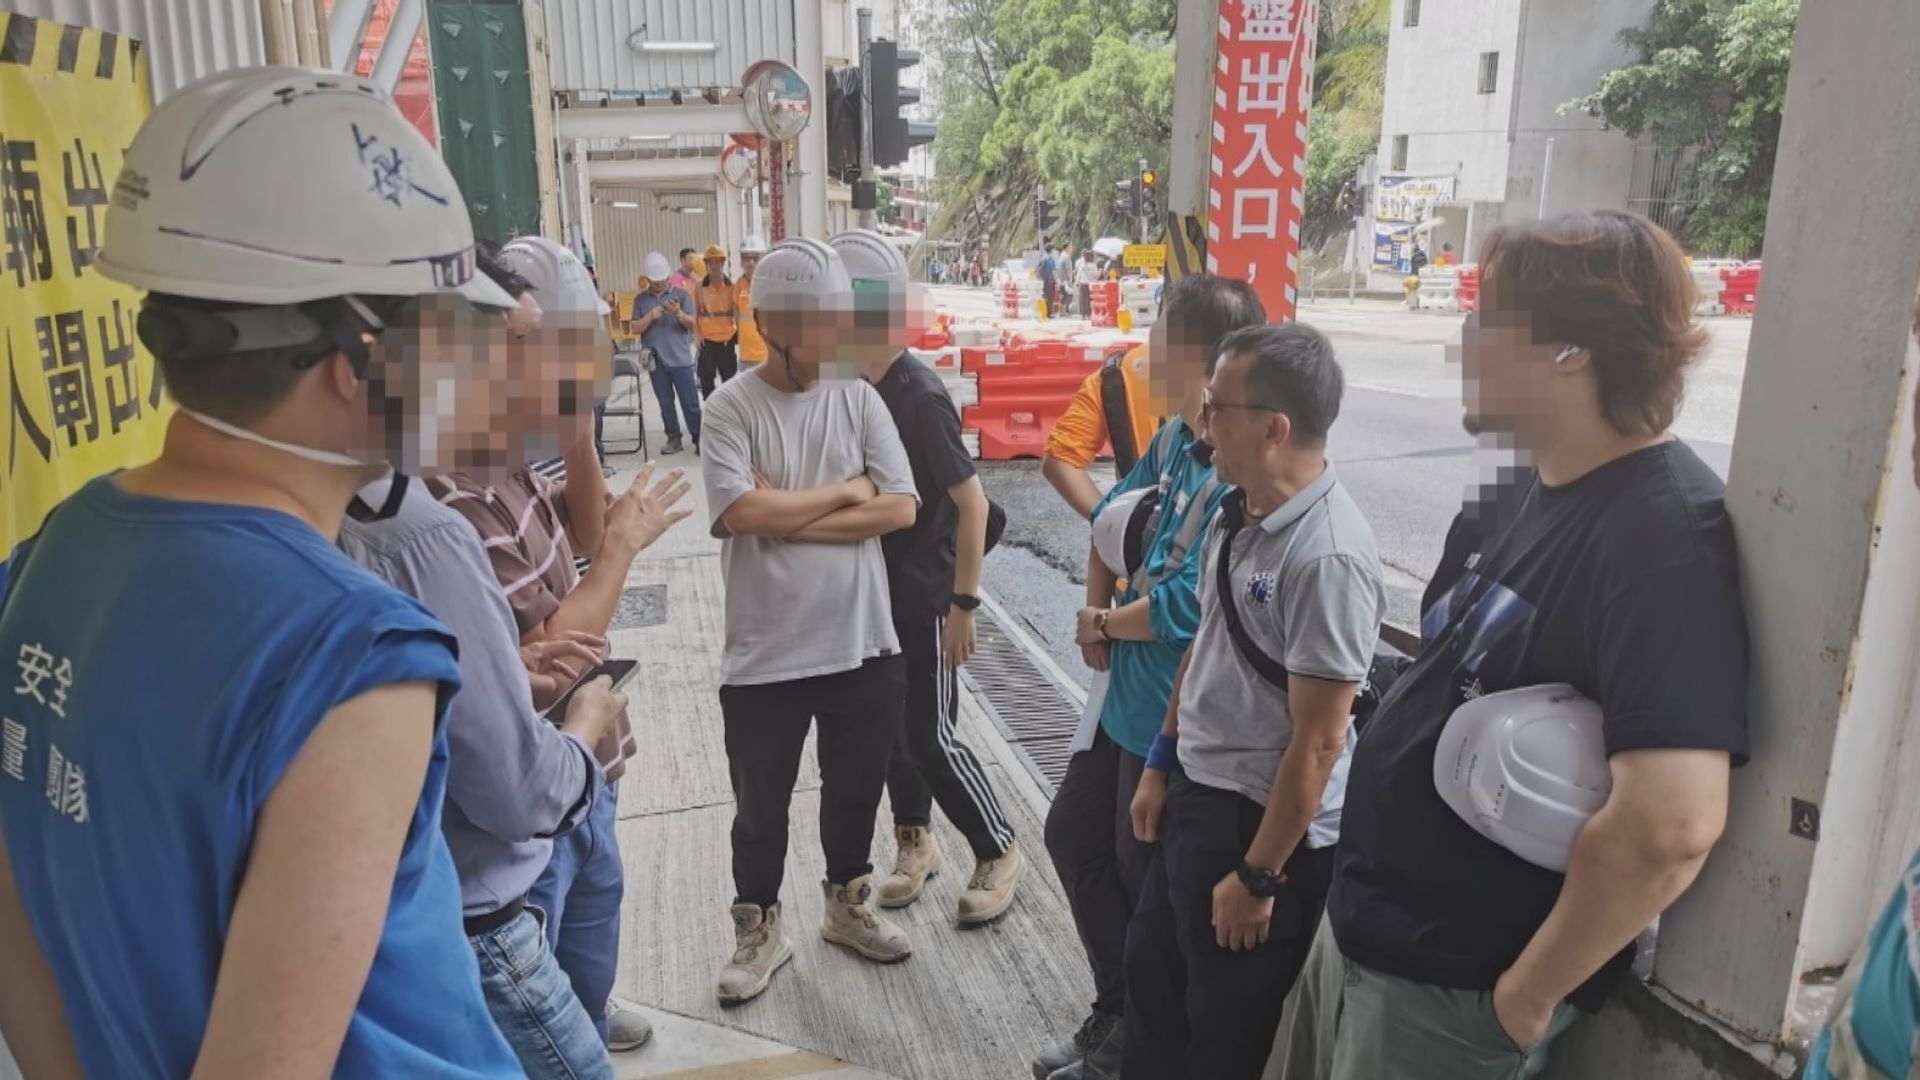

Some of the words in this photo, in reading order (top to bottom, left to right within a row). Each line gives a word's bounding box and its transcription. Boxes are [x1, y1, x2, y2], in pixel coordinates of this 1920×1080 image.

[0, 134, 131, 287] 輛出
[1, 300, 165, 480] 人閘出
[15, 642, 73, 719] 安全
